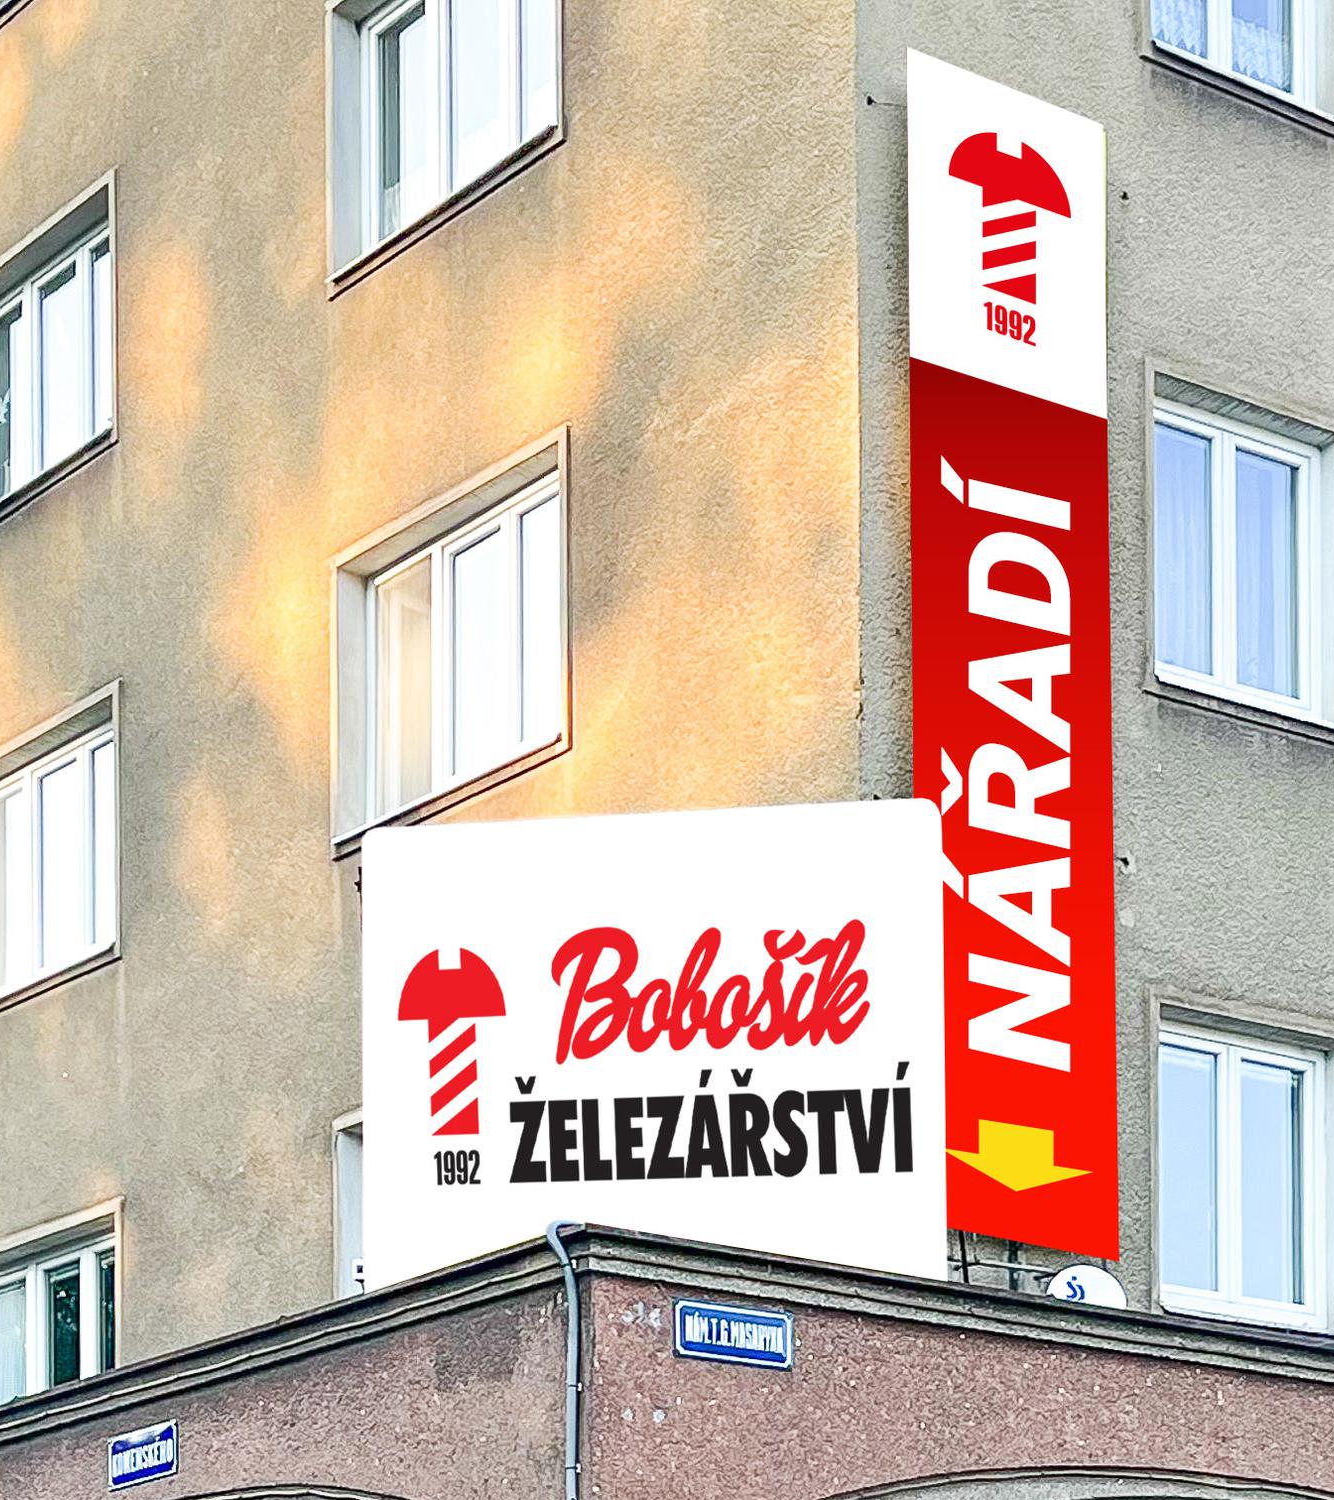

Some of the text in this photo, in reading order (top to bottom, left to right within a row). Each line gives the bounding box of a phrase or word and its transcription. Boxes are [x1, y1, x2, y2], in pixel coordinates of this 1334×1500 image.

[983, 301, 1036, 347] 1992
[940, 455, 1071, 1073] NÁŘADÍ
[551, 918, 870, 1065] Bobošík
[433, 1149, 481, 1186] 1992
[509, 1061, 914, 1184] ŽELEZÁŘSTVÍ
